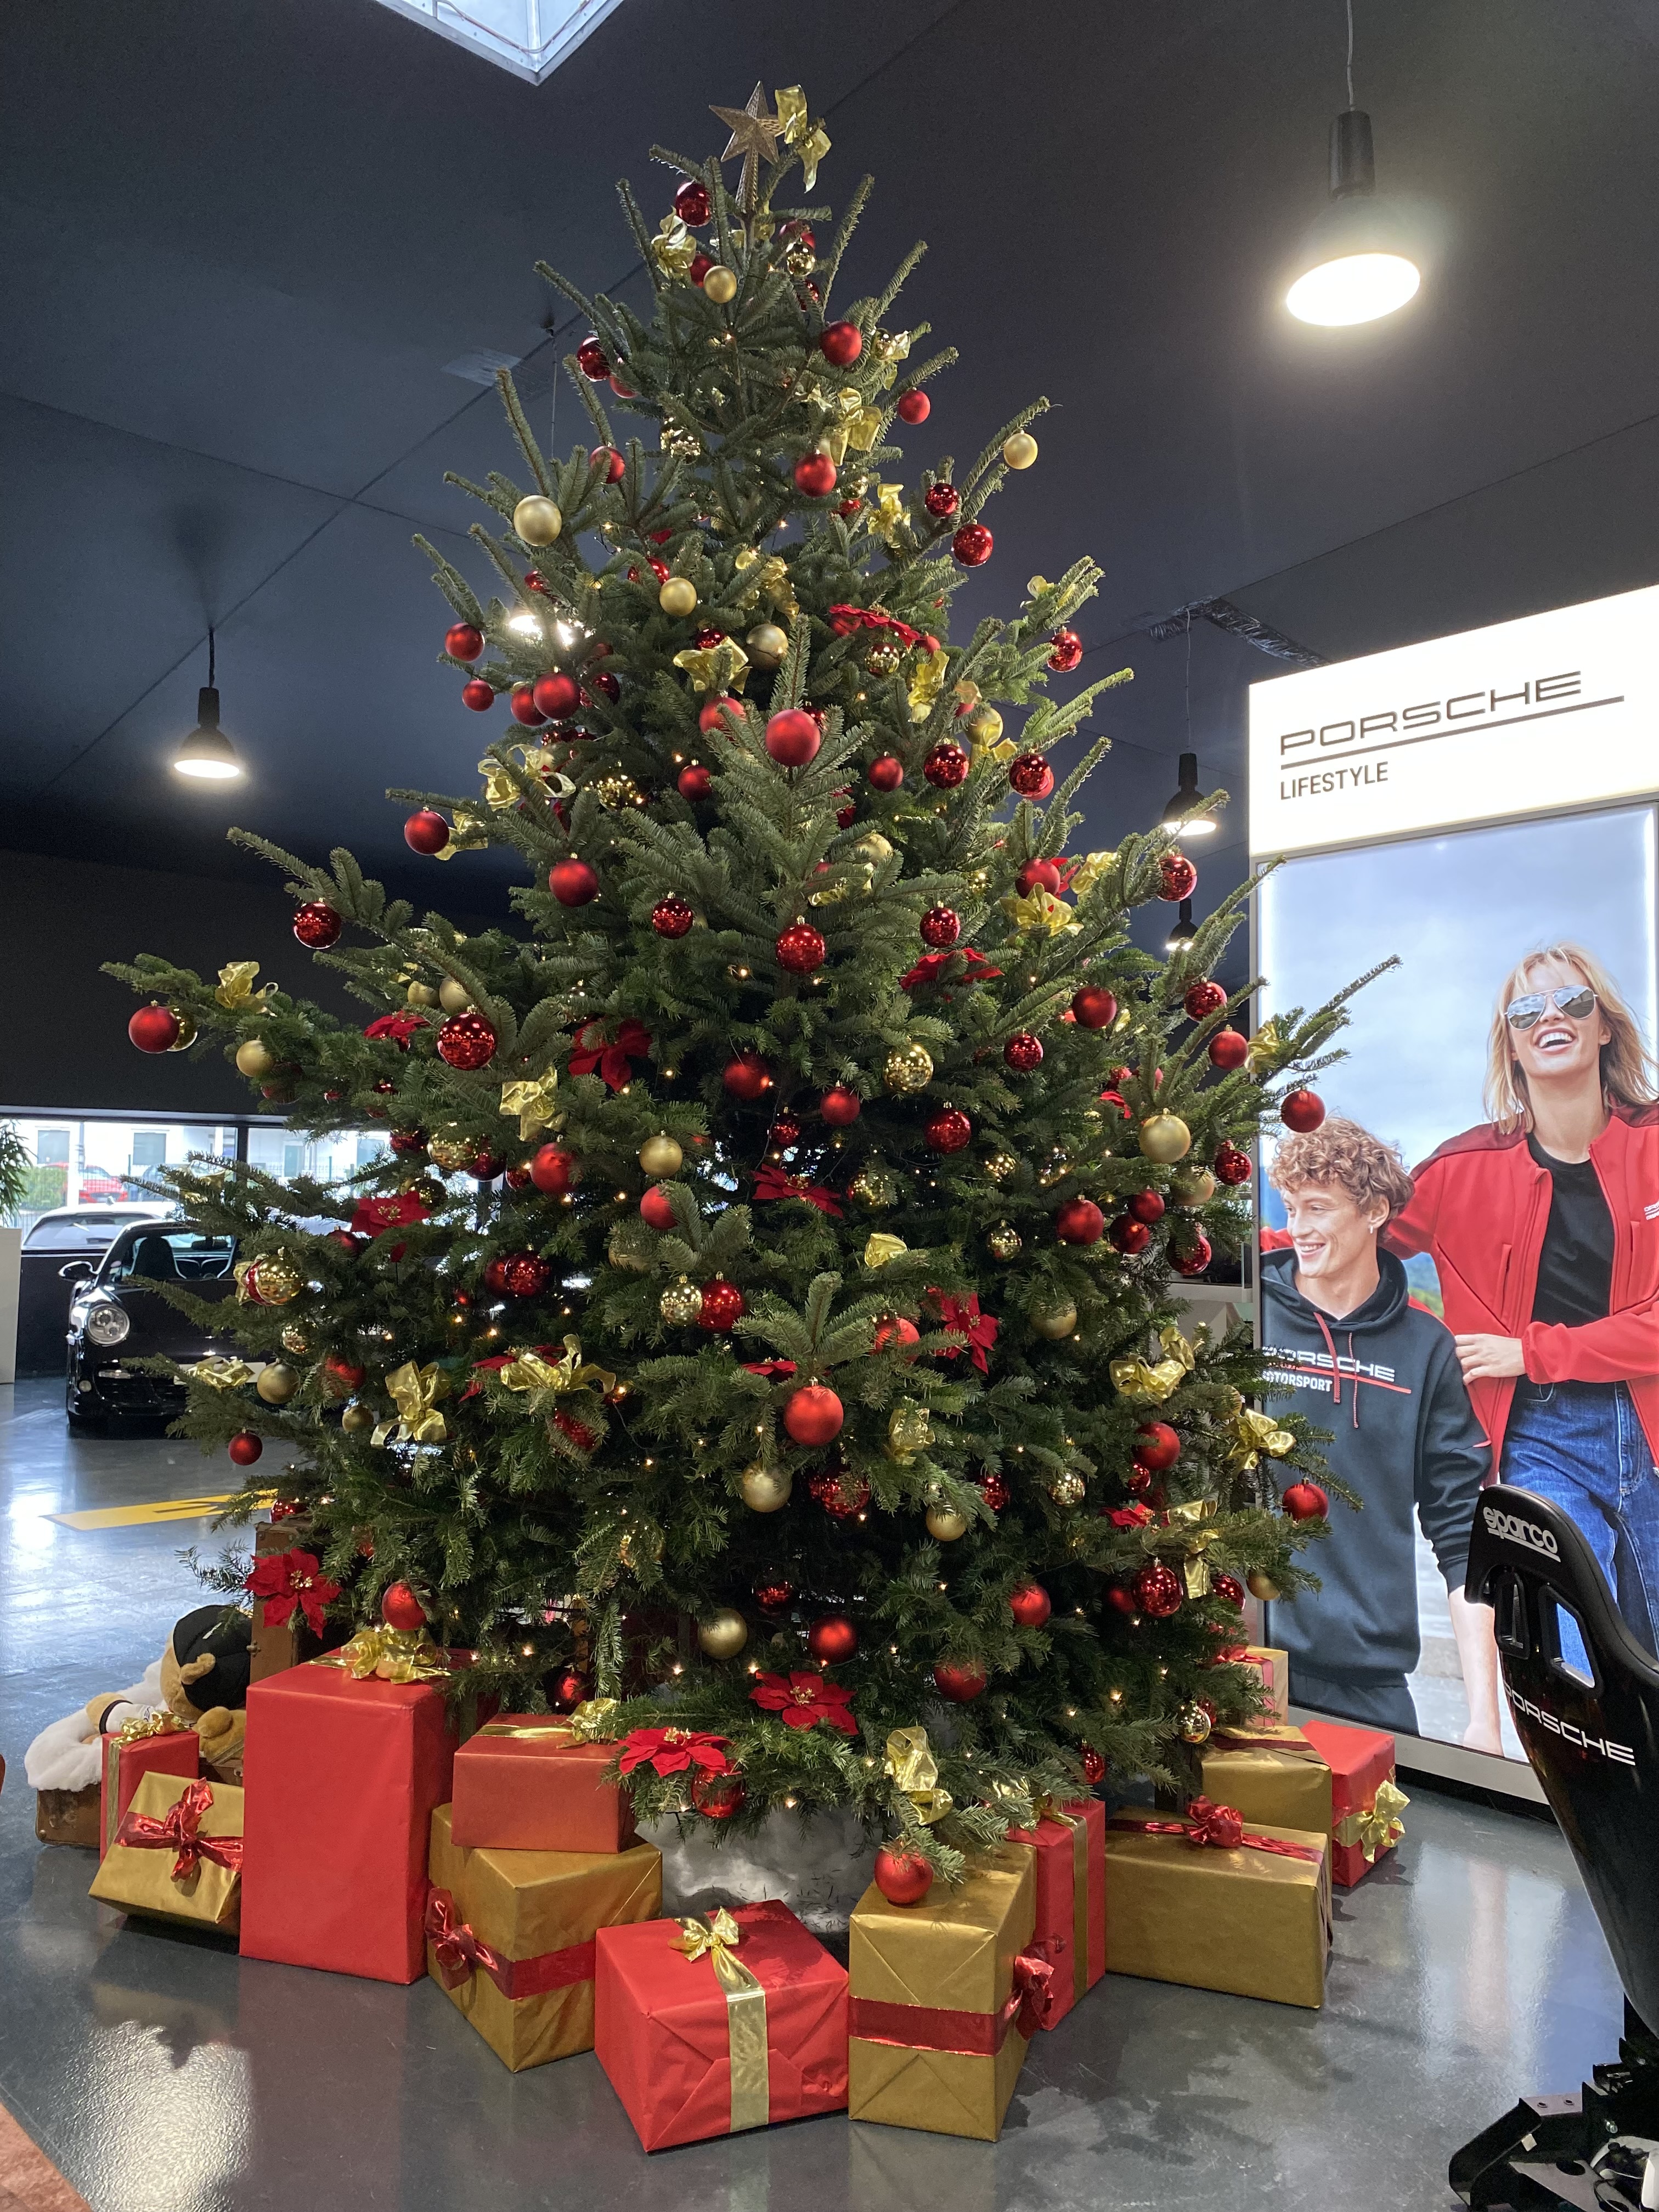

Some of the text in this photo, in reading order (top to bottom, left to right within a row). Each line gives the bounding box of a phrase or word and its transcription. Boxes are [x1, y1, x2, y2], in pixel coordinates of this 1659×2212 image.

[1280, 670, 1581, 755] PORSCHE
[1280, 761, 1389, 800] LIFESTYLE
[1483, 1506, 1558, 1554] sparco
